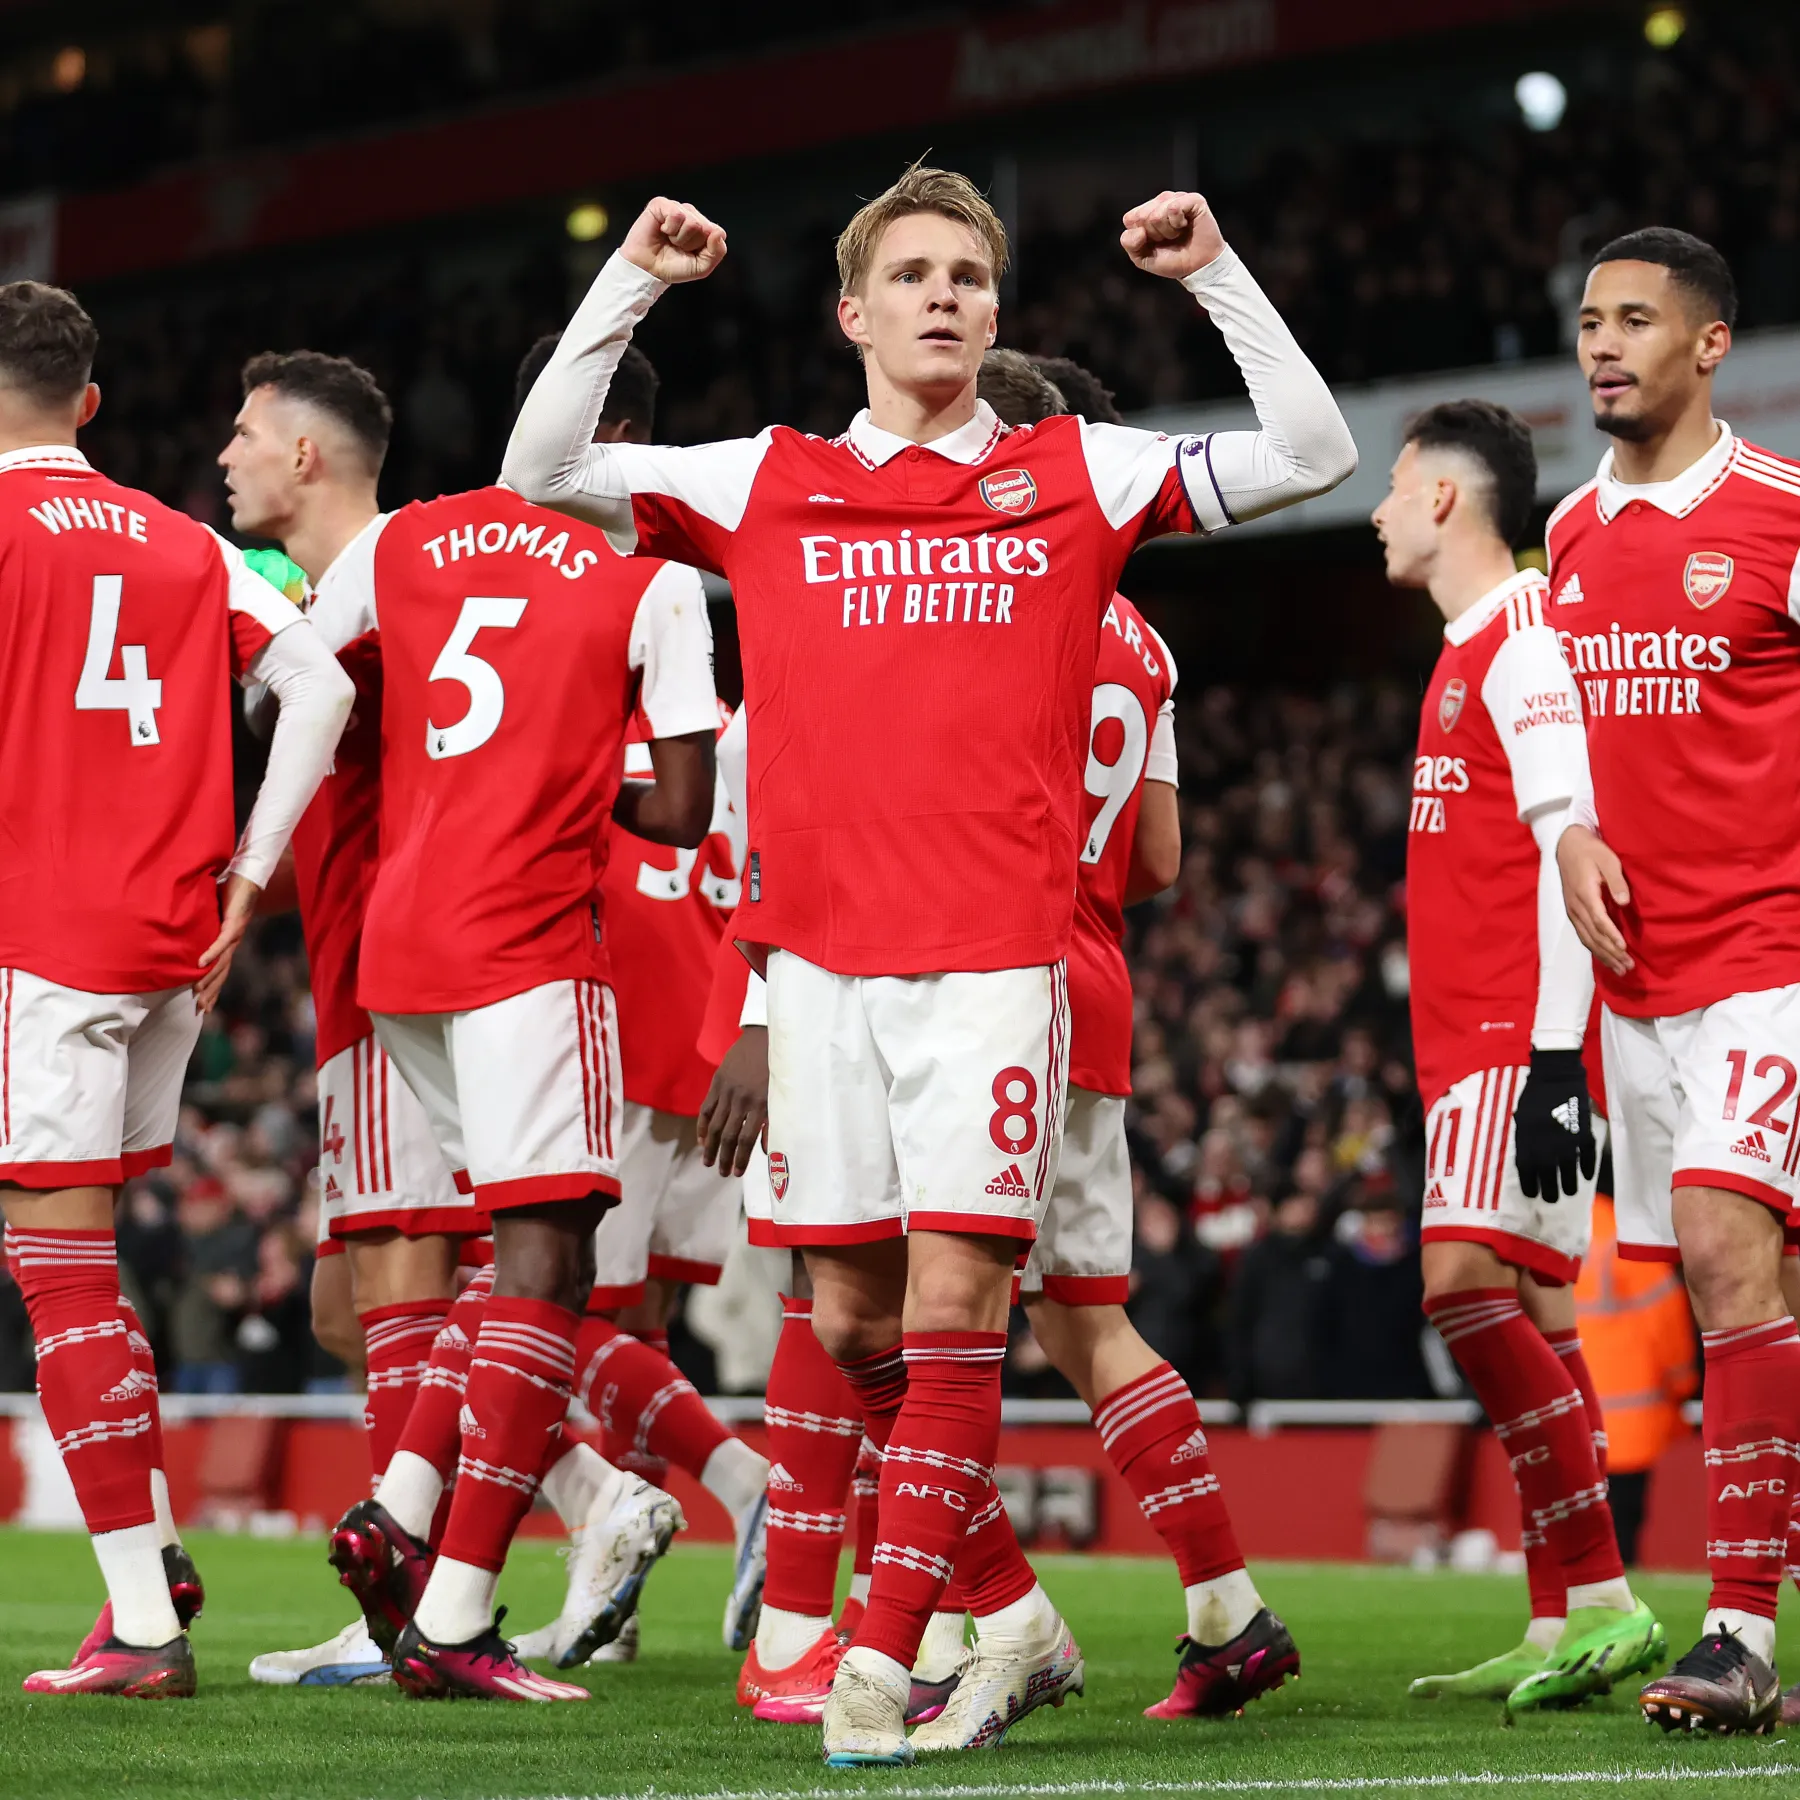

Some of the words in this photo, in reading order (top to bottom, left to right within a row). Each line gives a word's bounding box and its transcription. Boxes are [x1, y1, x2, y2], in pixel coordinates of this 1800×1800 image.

[987, 476, 1025, 493] Arsenal
[28, 496, 148, 544] WHITE
[422, 522, 598, 580] THOMAS
[799, 529, 1048, 583] Emirates
[843, 584, 892, 628] FLY
[903, 582, 1015, 624] BETTER
[75, 574, 163, 747] 4
[425, 597, 529, 760] 5
[1523, 691, 1569, 709] VISIT
[1615, 677, 1702, 716] BETTER
[989, 1066, 1037, 1154] 8
[1722, 1049, 1797, 1135] 12
[1730, 1144, 1771, 1163] adidas
[985, 1183, 1030, 1198] adidas
[1510, 1445, 1550, 1472] FC
[895, 1482, 966, 1511] AFC
[1718, 1479, 1786, 1502] AFC
